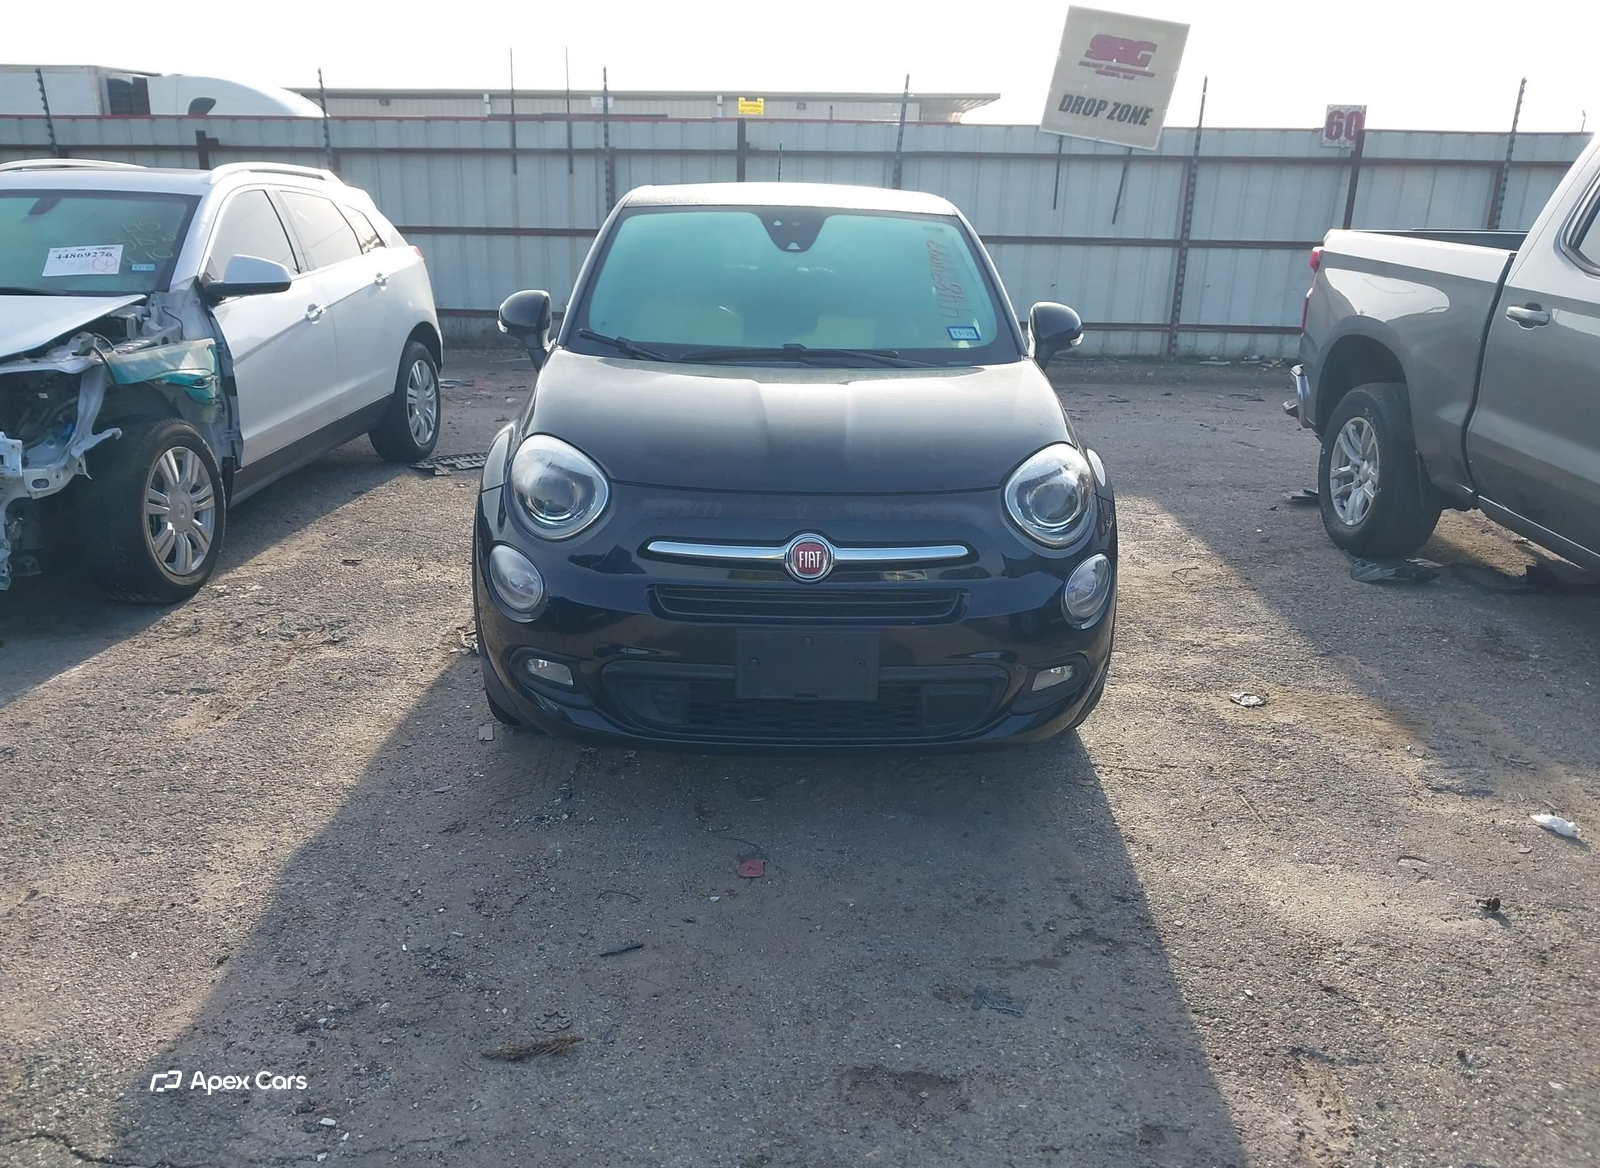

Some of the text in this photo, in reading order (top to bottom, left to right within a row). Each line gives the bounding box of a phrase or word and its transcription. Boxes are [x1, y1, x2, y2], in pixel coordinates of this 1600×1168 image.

[1058, 94, 1153, 126] DROP ZONE
[1325, 110, 1363, 140] 60
[55, 251, 113, 260] 44869276
[799, 551, 821, 568] FIAT
